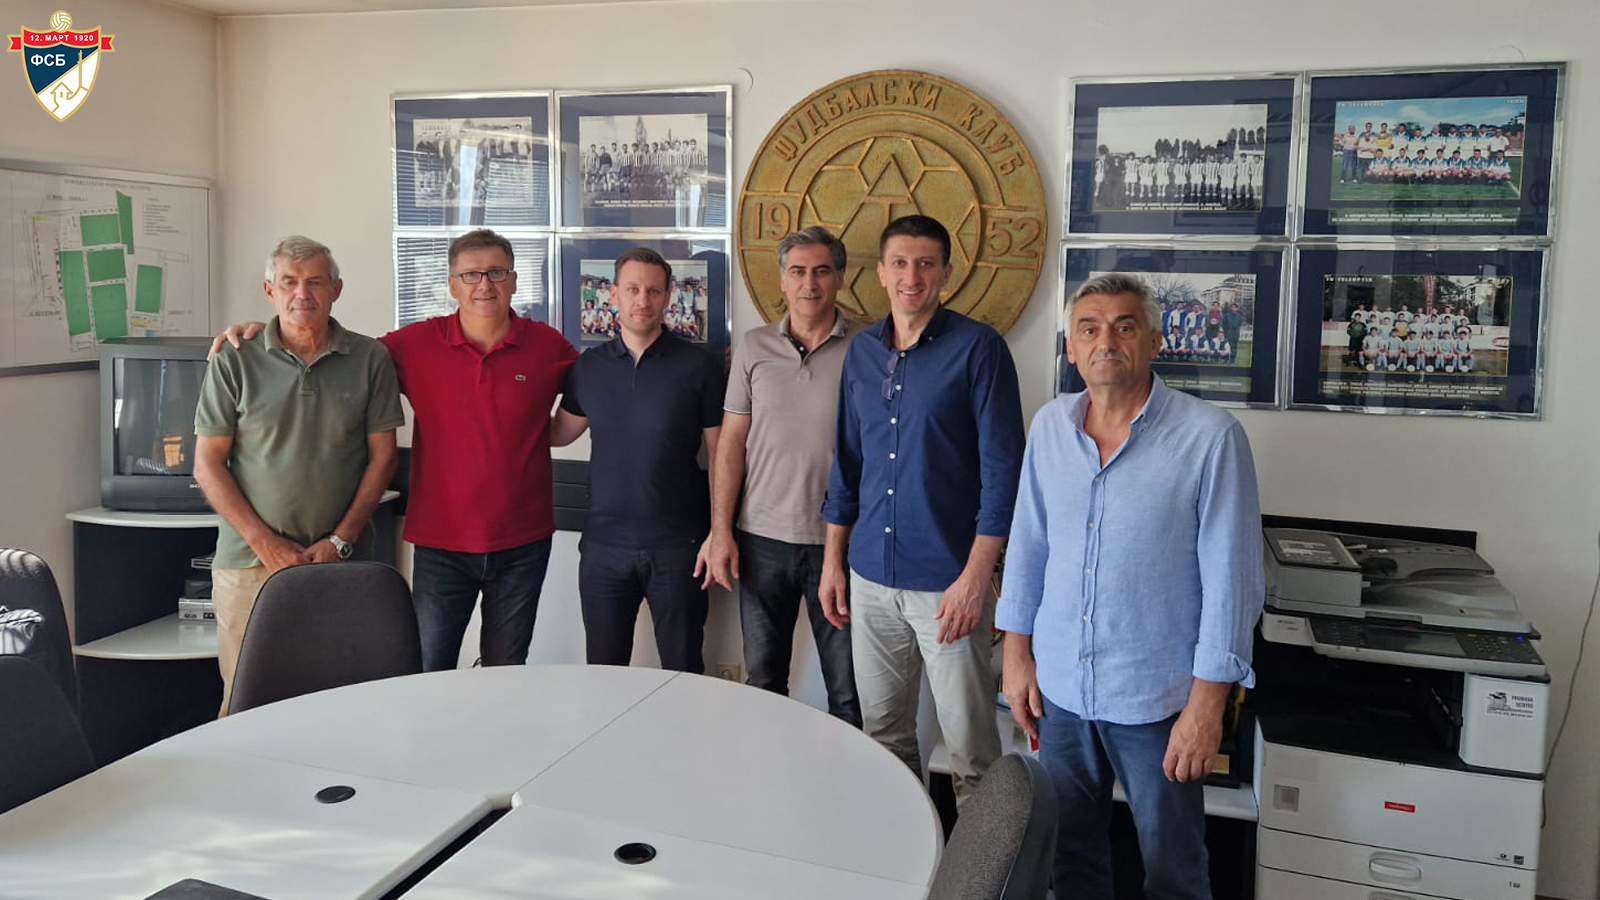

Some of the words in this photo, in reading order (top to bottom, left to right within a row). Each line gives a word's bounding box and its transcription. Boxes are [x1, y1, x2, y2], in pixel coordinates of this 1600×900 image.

[959, 102, 1024, 176] КЛУБ
[750, 201, 791, 241] 19
[985, 216, 1042, 260] 52
